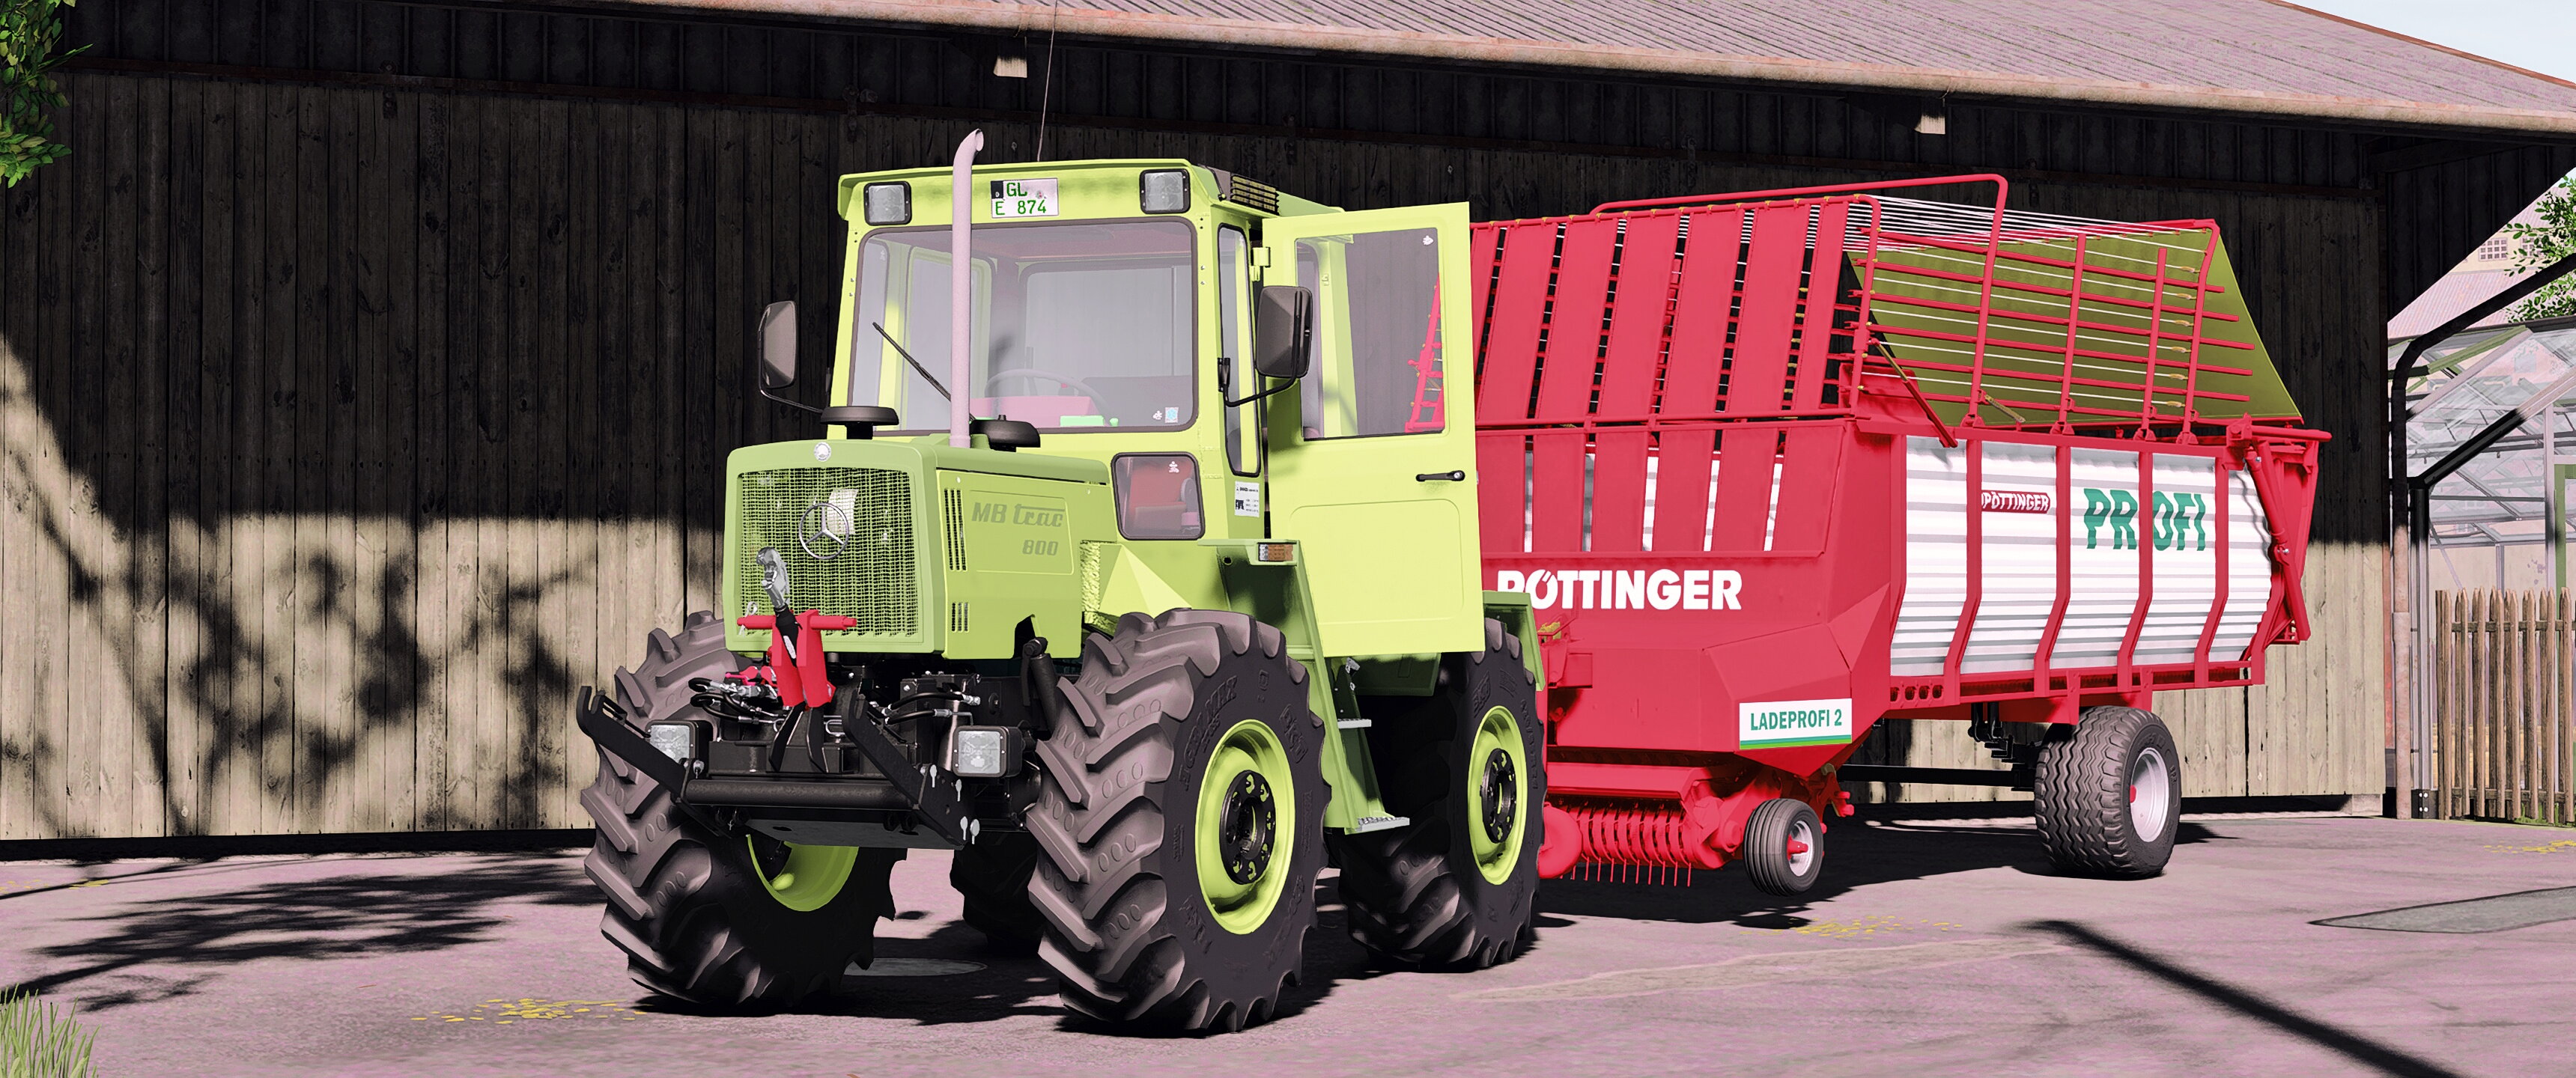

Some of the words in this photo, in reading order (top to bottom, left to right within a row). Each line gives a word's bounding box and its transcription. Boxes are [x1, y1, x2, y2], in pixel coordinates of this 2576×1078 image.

[1006, 182, 1027, 197] GL
[995, 201, 1005, 216] E
[1018, 199, 1046, 215] 874
[1982, 491, 2049, 511] PÖTTINGER
[971, 502, 1007, 523] MB
[1013, 504, 1065, 527] trac
[2084, 488, 2205, 551] PROFI
[1022, 540, 1058, 556] 800
[1751, 709, 1830, 731] LADEPROFI
[1834, 709, 1842, 726] 2
